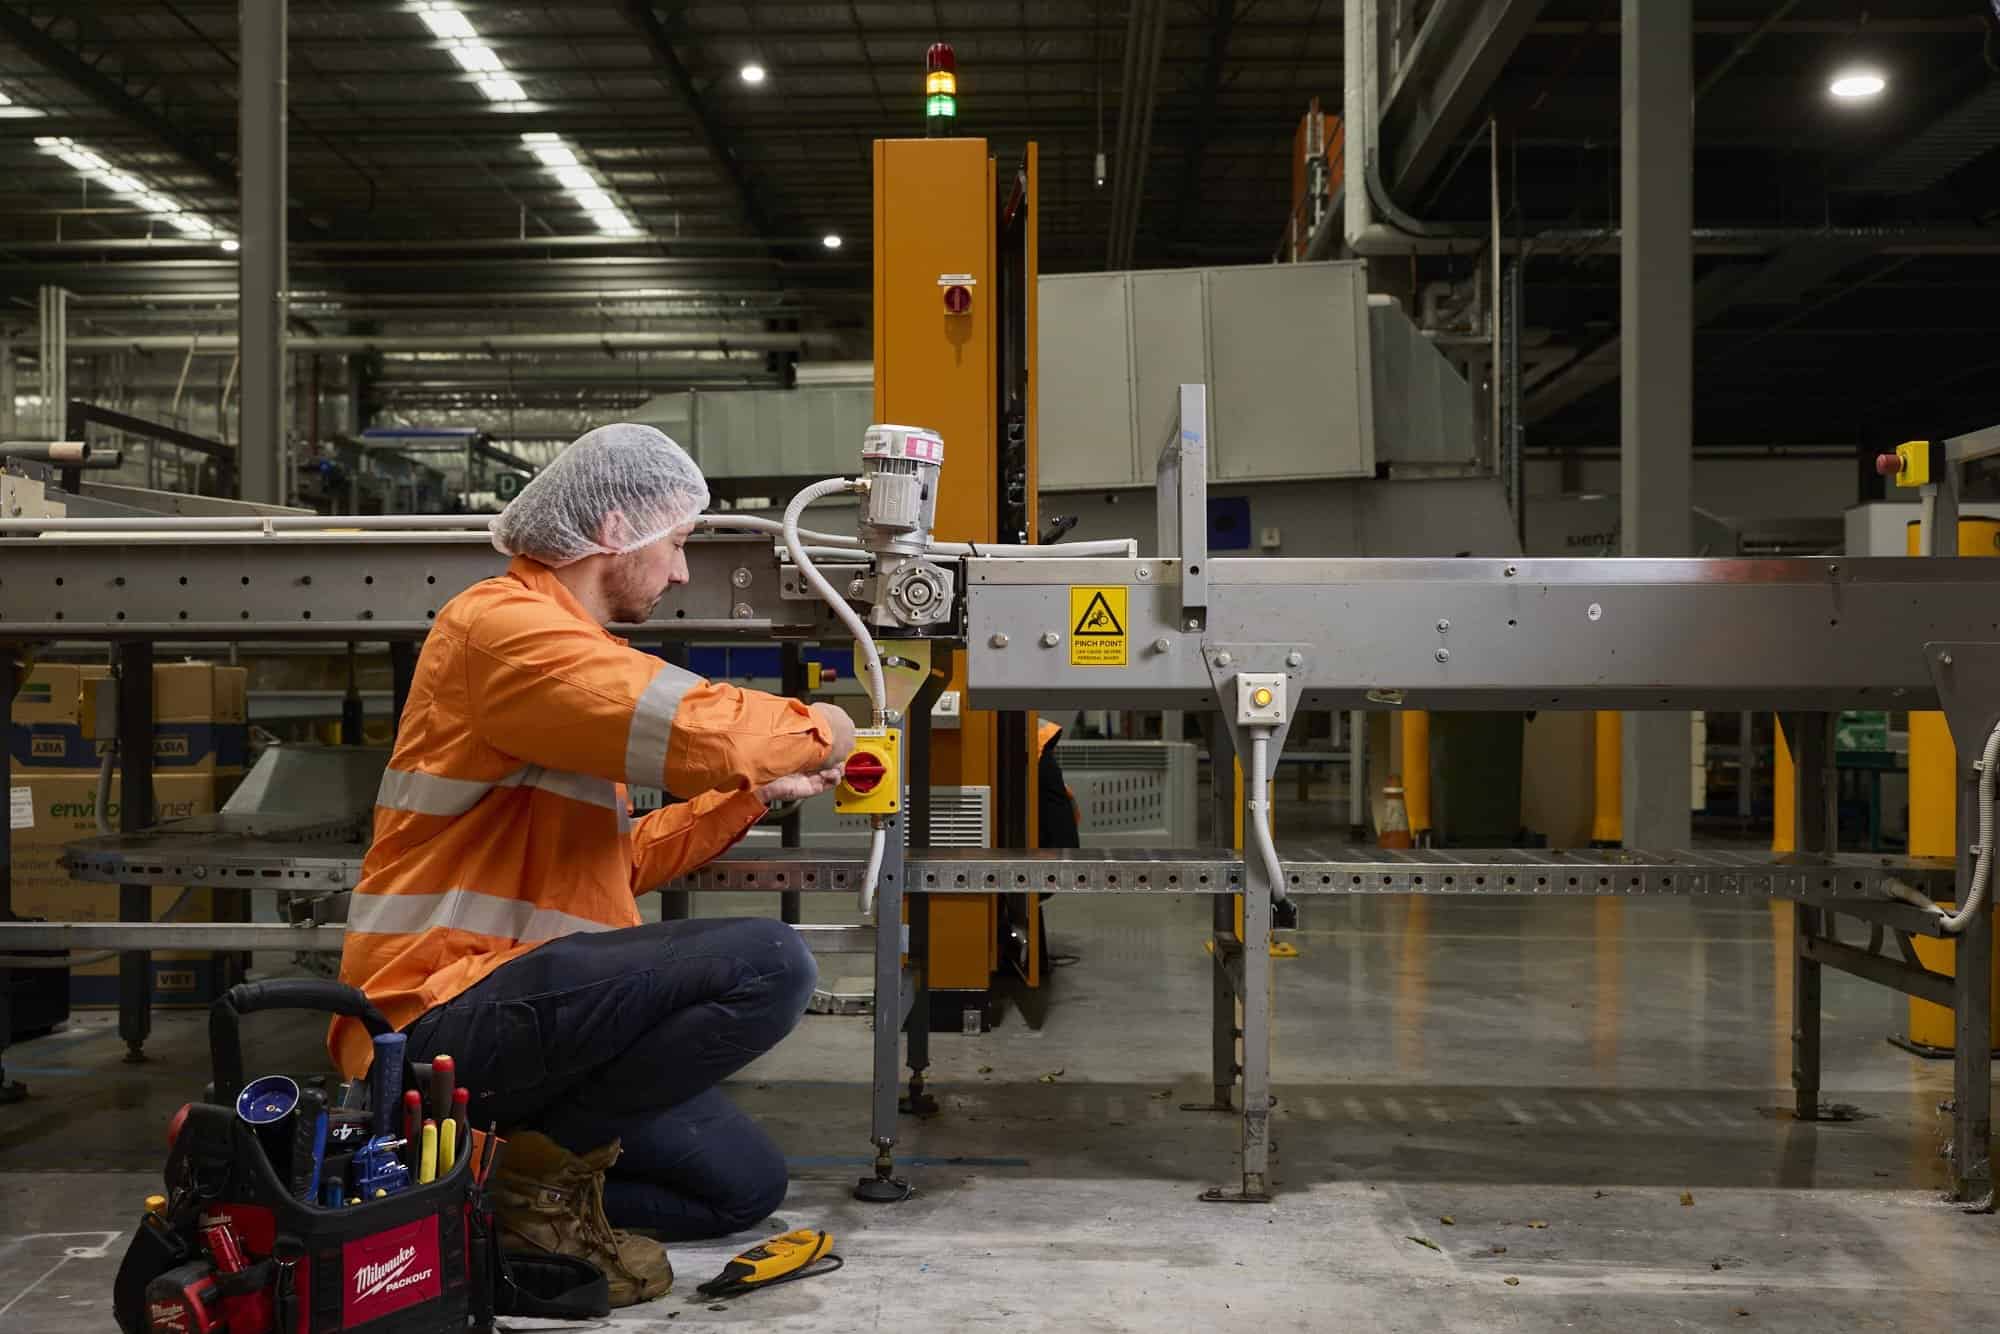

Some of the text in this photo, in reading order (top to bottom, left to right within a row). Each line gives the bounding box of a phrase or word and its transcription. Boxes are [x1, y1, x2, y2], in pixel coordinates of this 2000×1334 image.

[50, 798, 120, 817] envio
[353, 1245, 416, 1294] Milwaukee
[386, 1268, 433, 1294] PACKOUT
